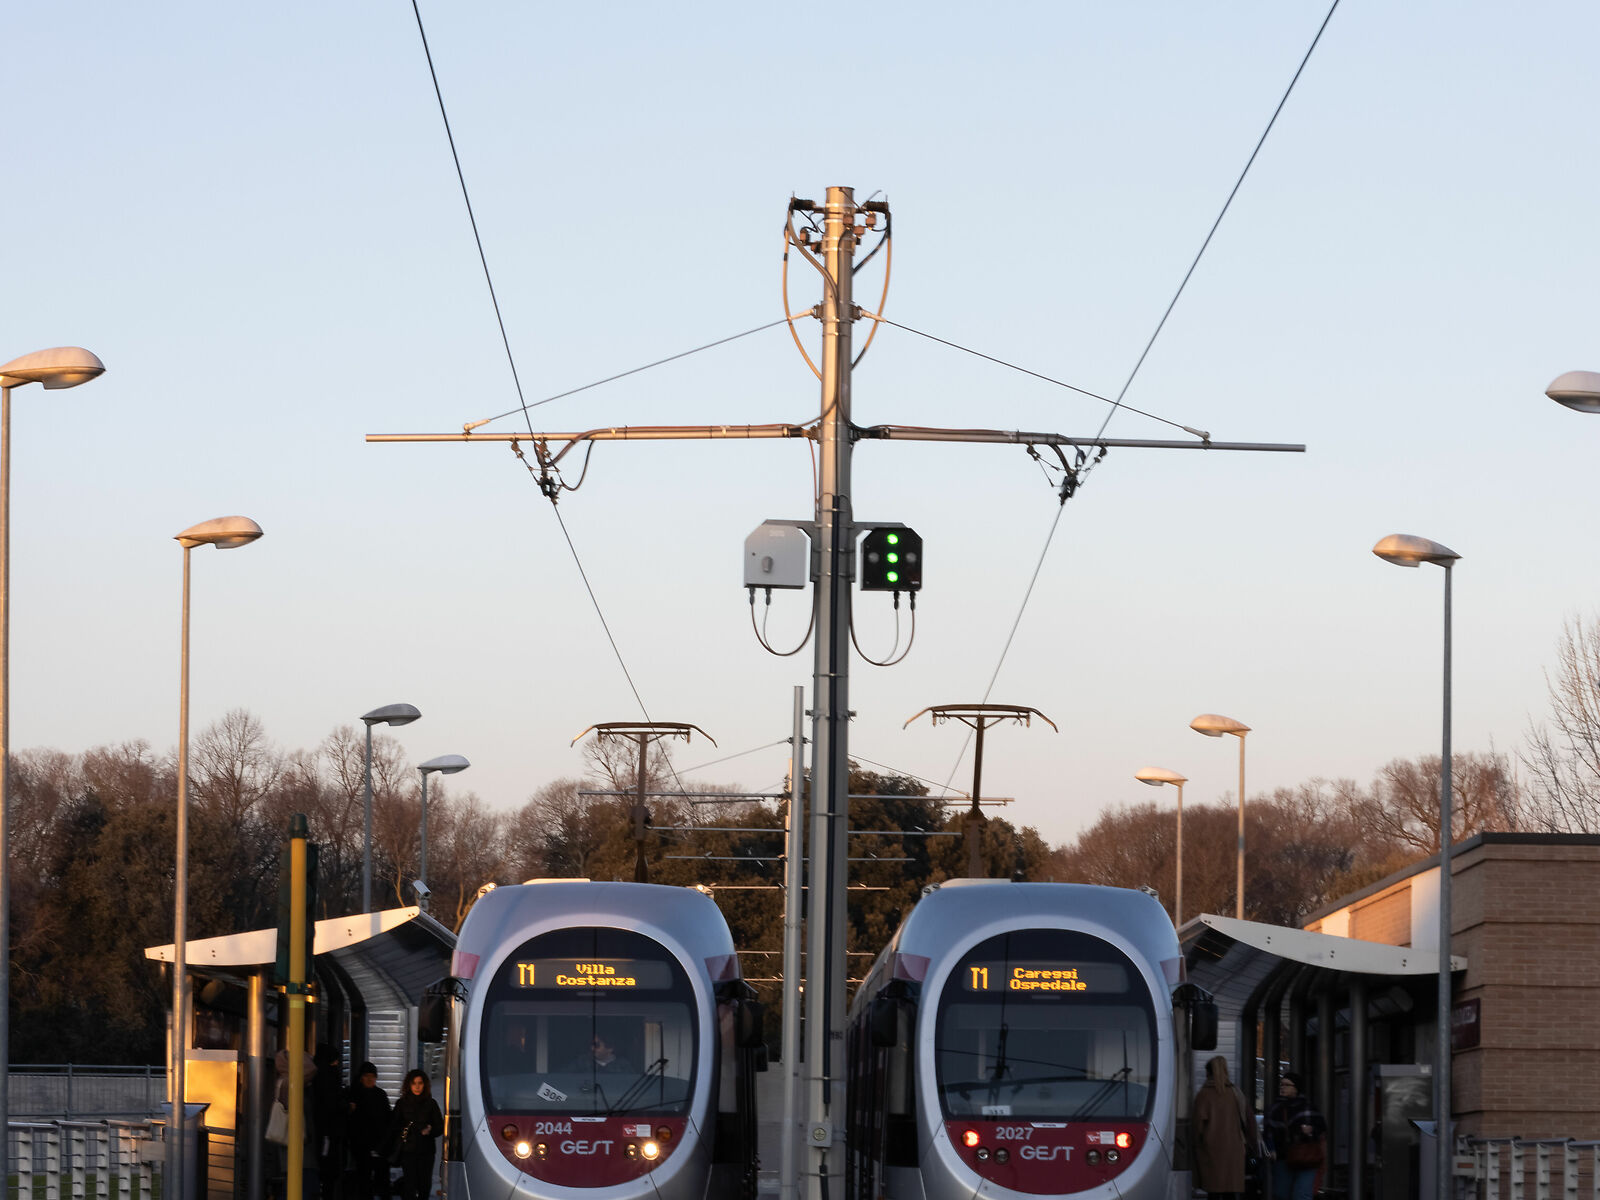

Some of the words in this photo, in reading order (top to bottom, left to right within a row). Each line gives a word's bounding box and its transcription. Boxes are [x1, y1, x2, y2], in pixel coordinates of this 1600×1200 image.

[518, 963, 535, 986] T1
[576, 964, 615, 975] Villa
[556, 975, 636, 986] Costanza
[970, 967, 988, 990] T1
[1009, 979, 1087, 991] Ospedale
[536, 1122, 573, 1135] 2044
[996, 1127, 1034, 1140] 2027
[560, 1140, 614, 1155] GEST
[1020, 1146, 1075, 1161] GEST
